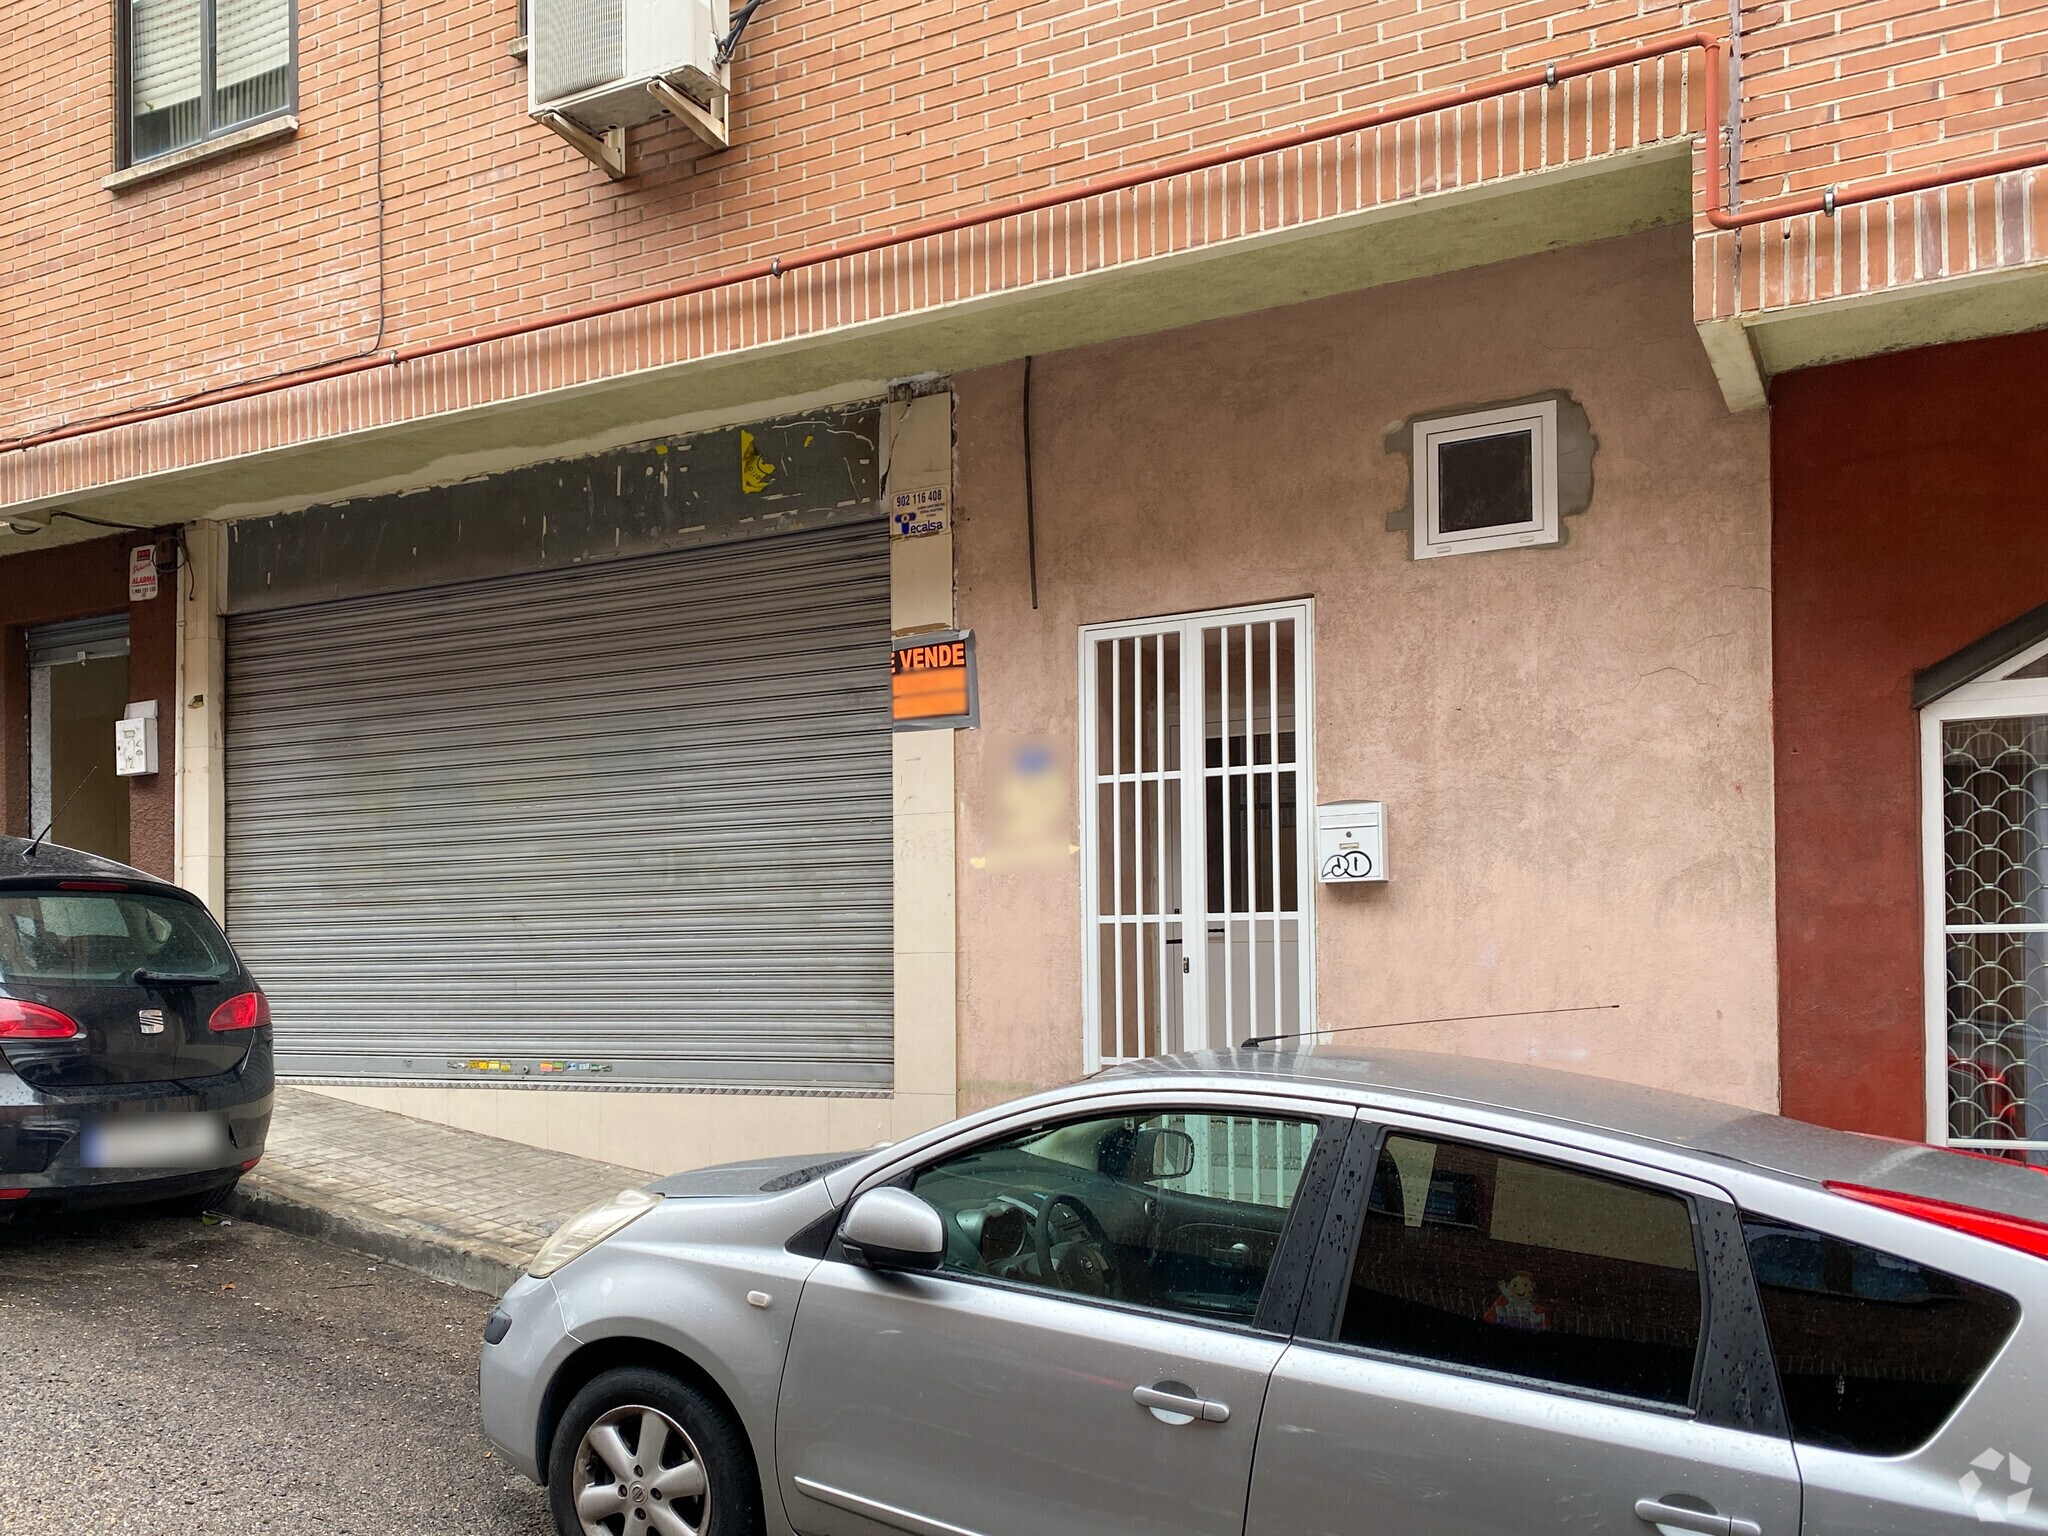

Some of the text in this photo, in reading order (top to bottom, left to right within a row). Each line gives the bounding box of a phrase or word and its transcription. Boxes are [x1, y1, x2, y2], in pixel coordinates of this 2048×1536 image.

[896, 494, 910, 508] 902
[912, 492, 926, 505] 116
[928, 489, 942, 502] 408
[131, 575, 156, 585] ALARMA
[899, 643, 965, 669] VENDE
